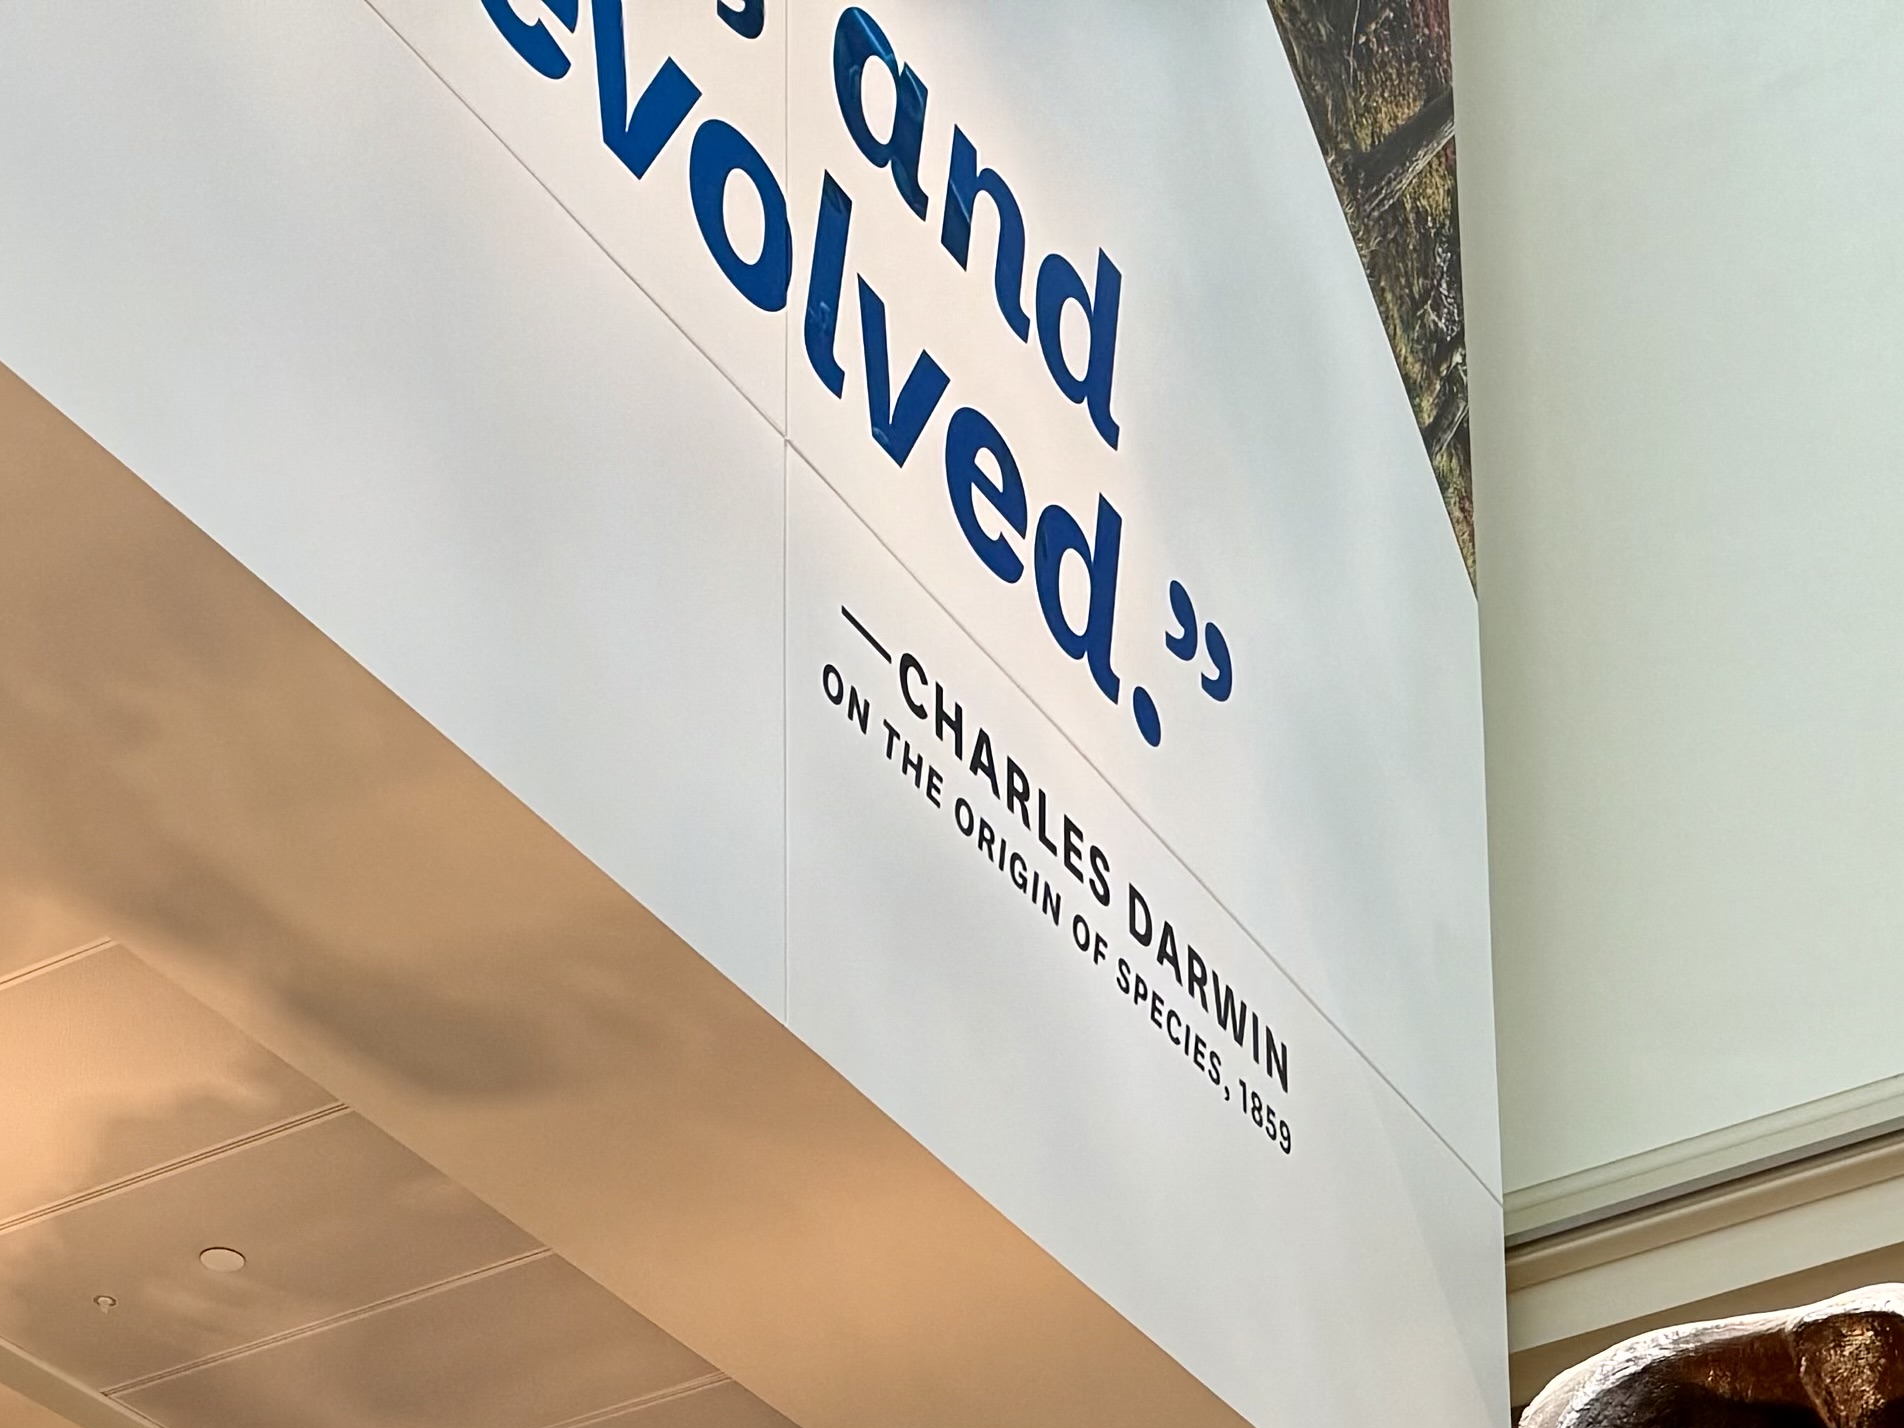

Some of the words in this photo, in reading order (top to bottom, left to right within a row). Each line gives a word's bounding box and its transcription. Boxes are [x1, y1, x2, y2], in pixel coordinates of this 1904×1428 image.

[833, 6, 1122, 452] and
[823, 664, 870, 735] ON
[883, 718, 944, 809] THE
[955, 797, 1061, 927] ORIGIN
[1073, 914, 1108, 965] OF
[1116, 958, 1230, 1101] SPECIES,
[1239, 1078, 1291, 1155] 1859
[1129, 882, 1288, 1094] DARWIN
